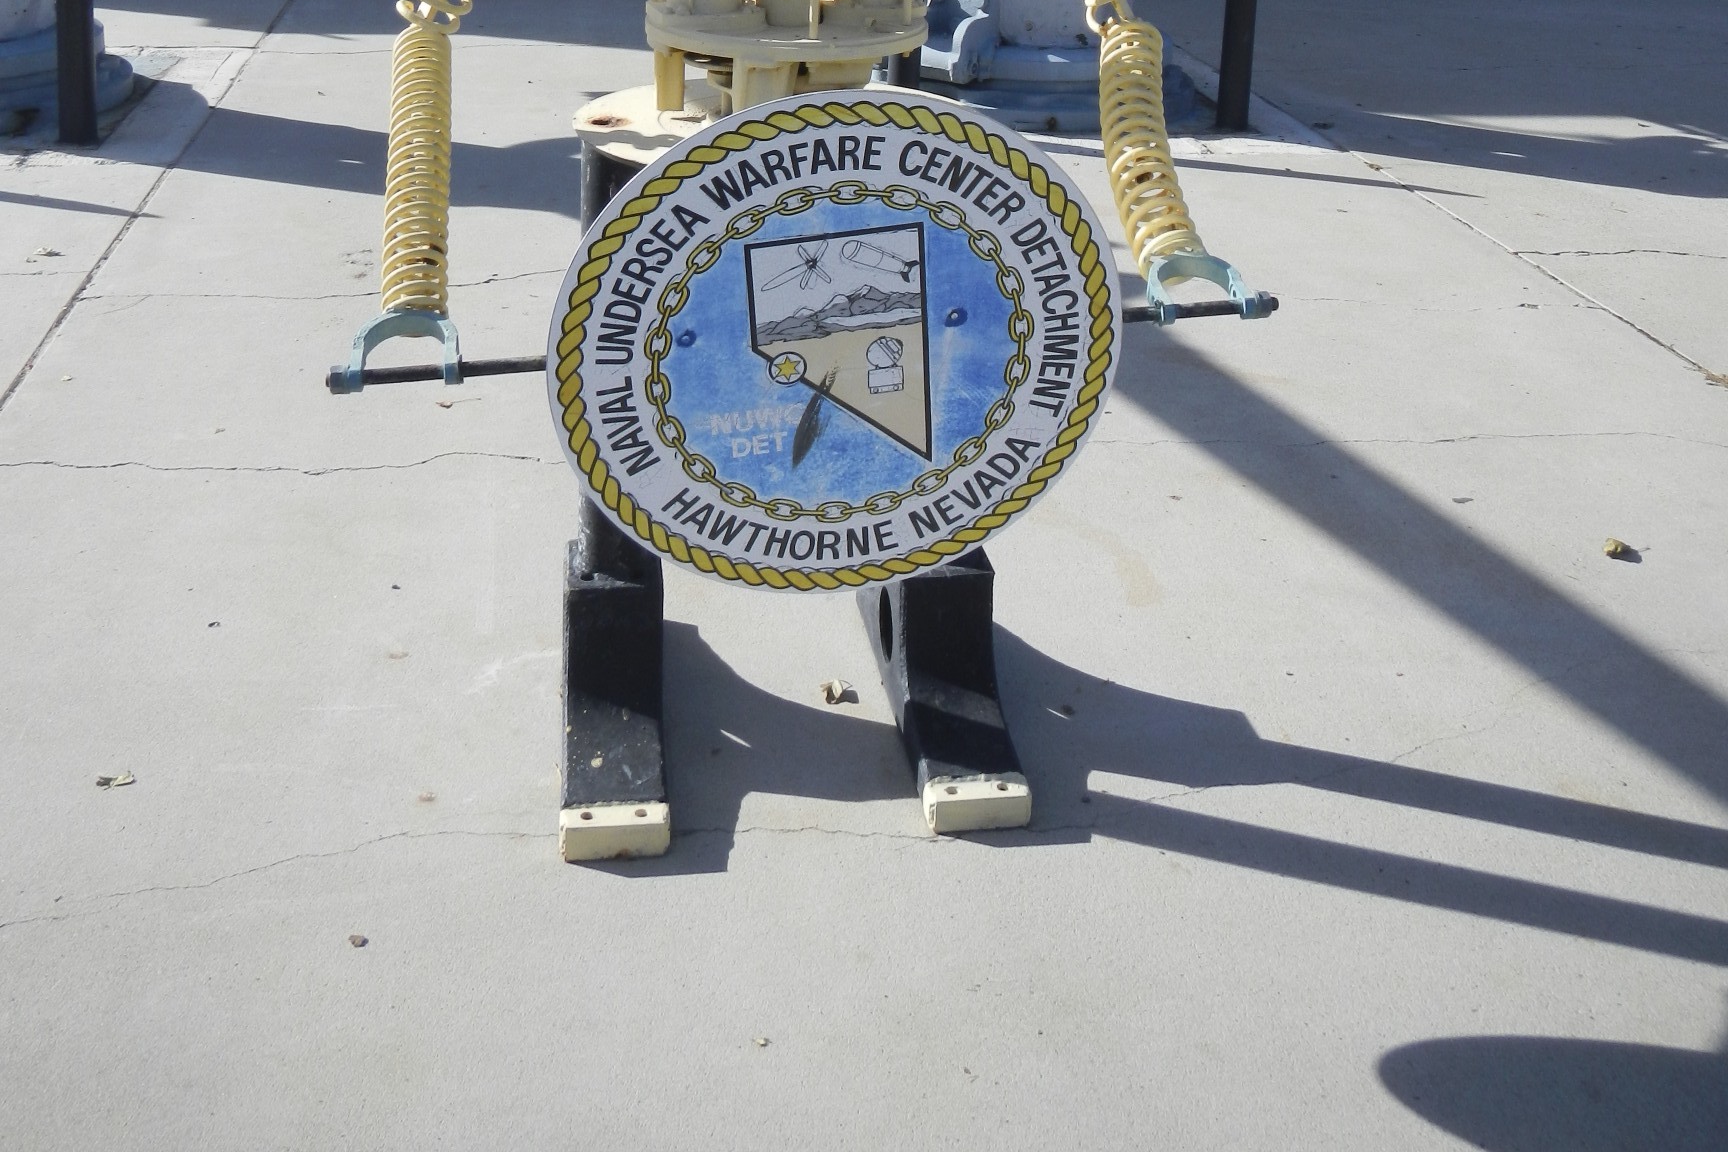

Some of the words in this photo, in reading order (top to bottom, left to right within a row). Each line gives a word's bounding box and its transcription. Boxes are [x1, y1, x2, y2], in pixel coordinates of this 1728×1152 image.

[700, 135, 886, 211] WARFARE
[900, 140, 1026, 225] CENTER
[595, 204, 711, 365] UNDERSEA
[1010, 217, 1077, 417] DETACHMENT
[595, 375, 661, 477] NAVAL
[731, 431, 788, 459] DET
[661, 487, 899, 561] HAWTHORNE
[908, 436, 1041, 539] NEVADA
